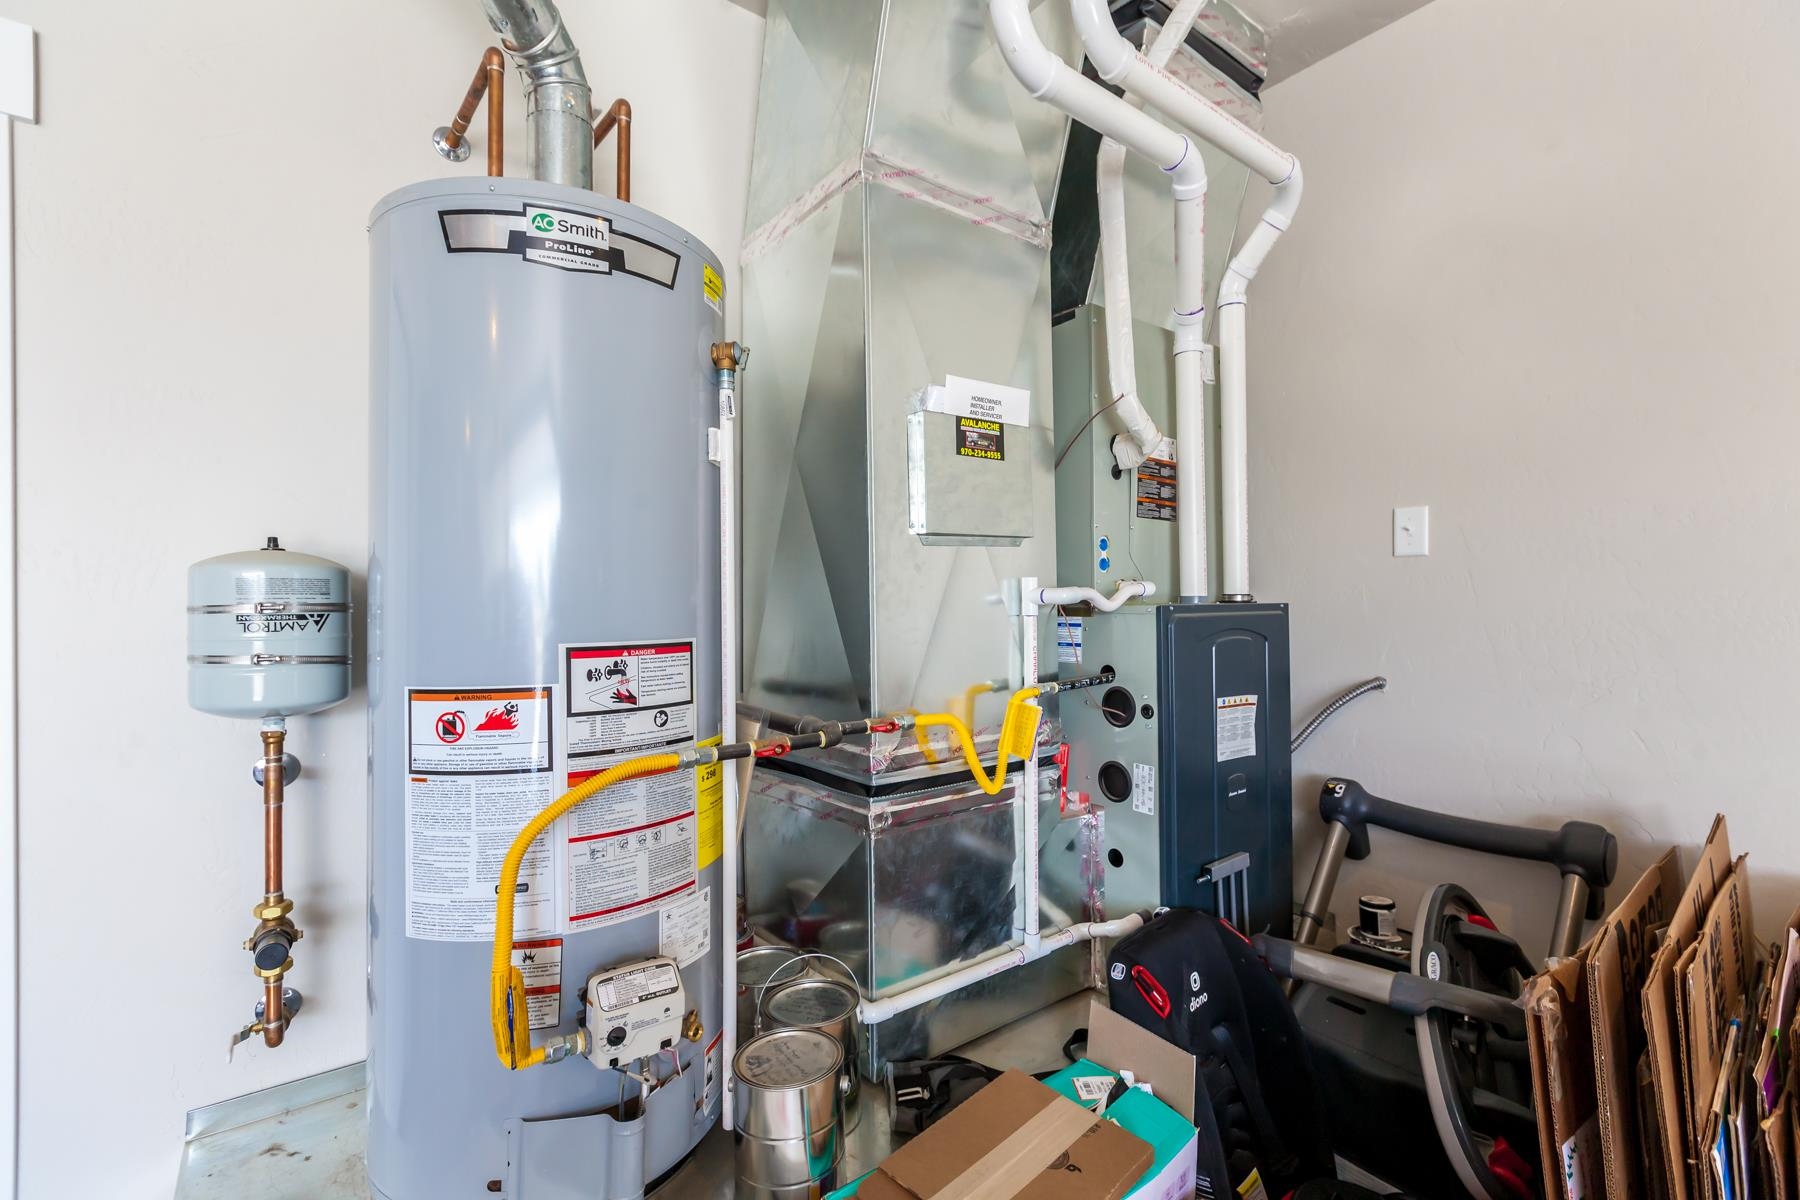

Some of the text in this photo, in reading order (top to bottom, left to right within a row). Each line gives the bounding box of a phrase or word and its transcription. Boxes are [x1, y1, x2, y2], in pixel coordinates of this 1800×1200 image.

[557, 220, 605, 240] Smith
[545, 241, 592, 255] ProLine
[970, 409, 1003, 420] AND SERVICER
[961, 418, 1000, 432] AVALANCHE
[961, 448, 1001, 460] 970-234-9555
[238, 621, 309, 633] AMTROL
[630, 649, 656, 657] DANGER
[1190, 993, 1208, 1012] diono
